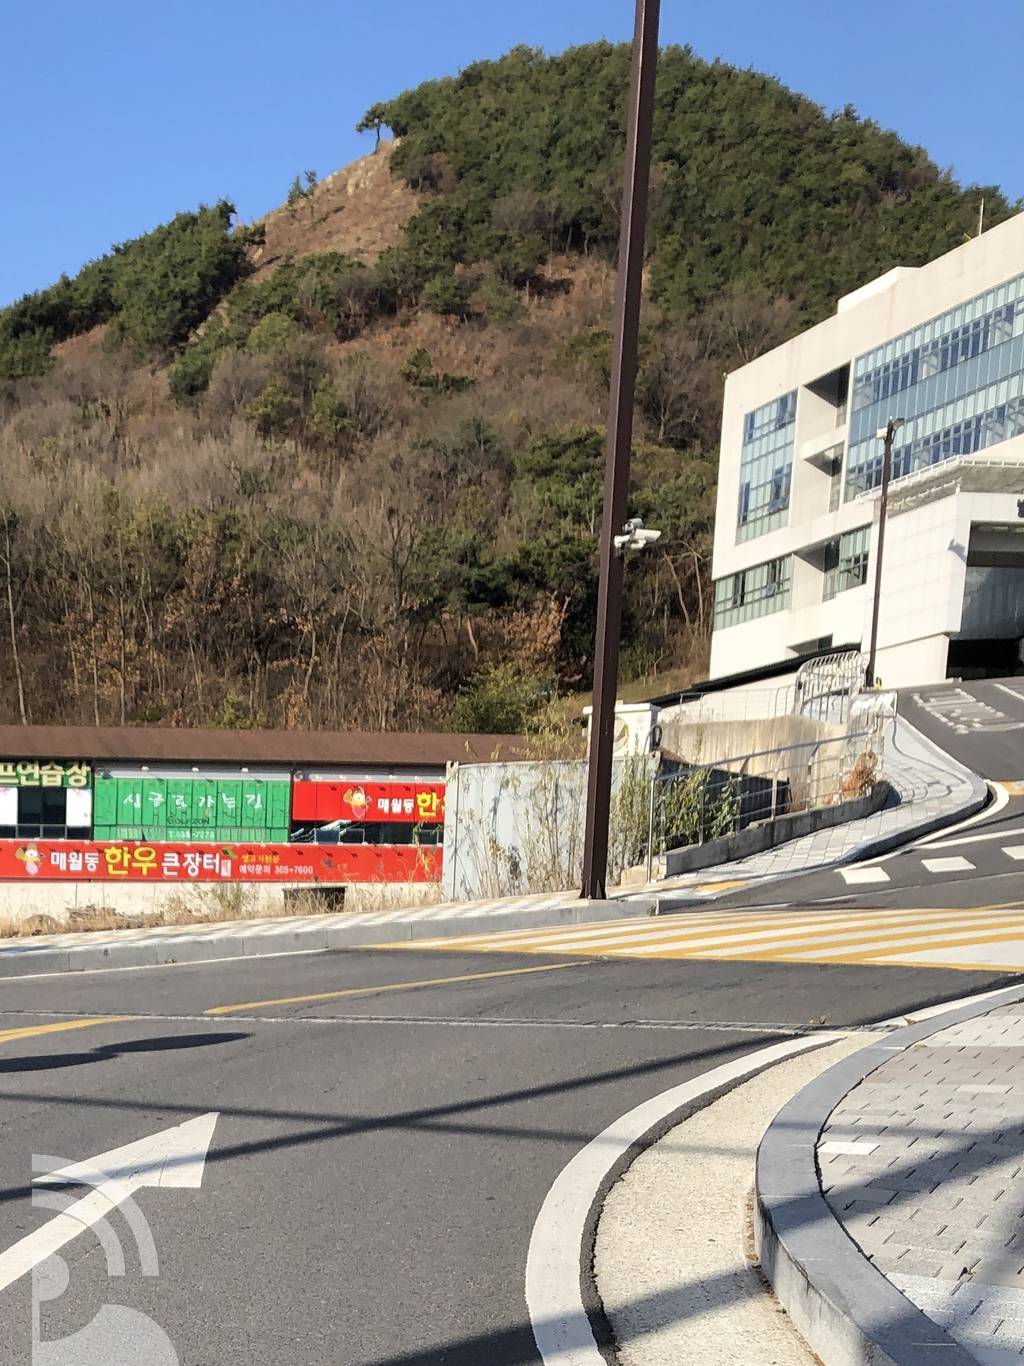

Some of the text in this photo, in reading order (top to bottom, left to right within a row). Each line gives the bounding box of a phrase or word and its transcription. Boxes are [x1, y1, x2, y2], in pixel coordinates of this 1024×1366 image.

[378, 792, 446, 817] 매월동 한
[50, 852, 99, 872] 매월동
[104, 847, 157, 876] 한우
